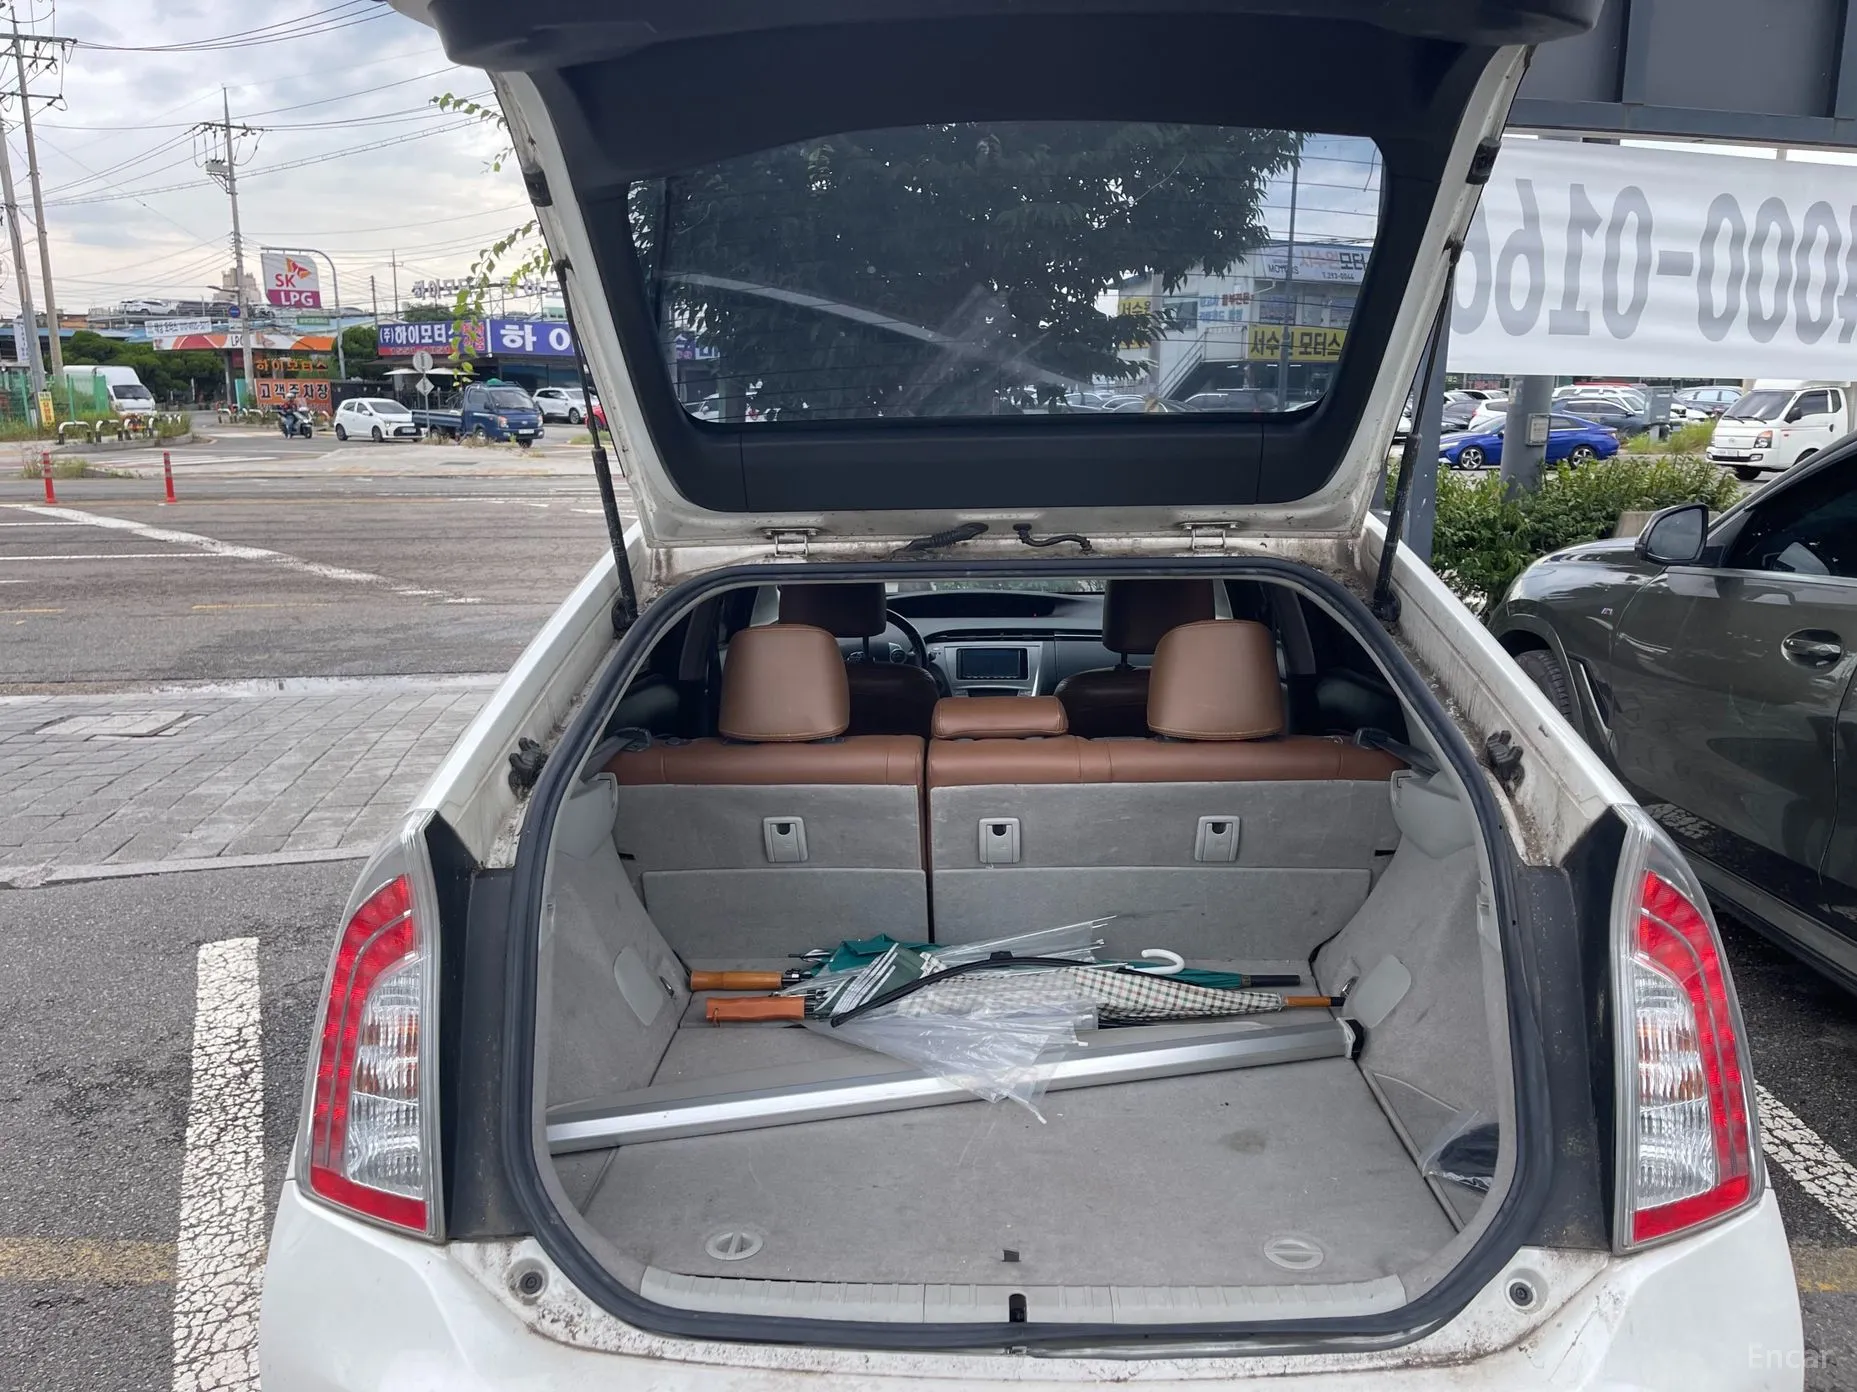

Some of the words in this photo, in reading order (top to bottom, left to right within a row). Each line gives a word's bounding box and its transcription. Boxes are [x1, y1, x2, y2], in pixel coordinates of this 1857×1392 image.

[275, 273, 296, 288] SK
[280, 291, 313, 306] LPG
[1299, 332, 1342, 357] 모터스
[259, 383, 328, 400] 고객주차장
